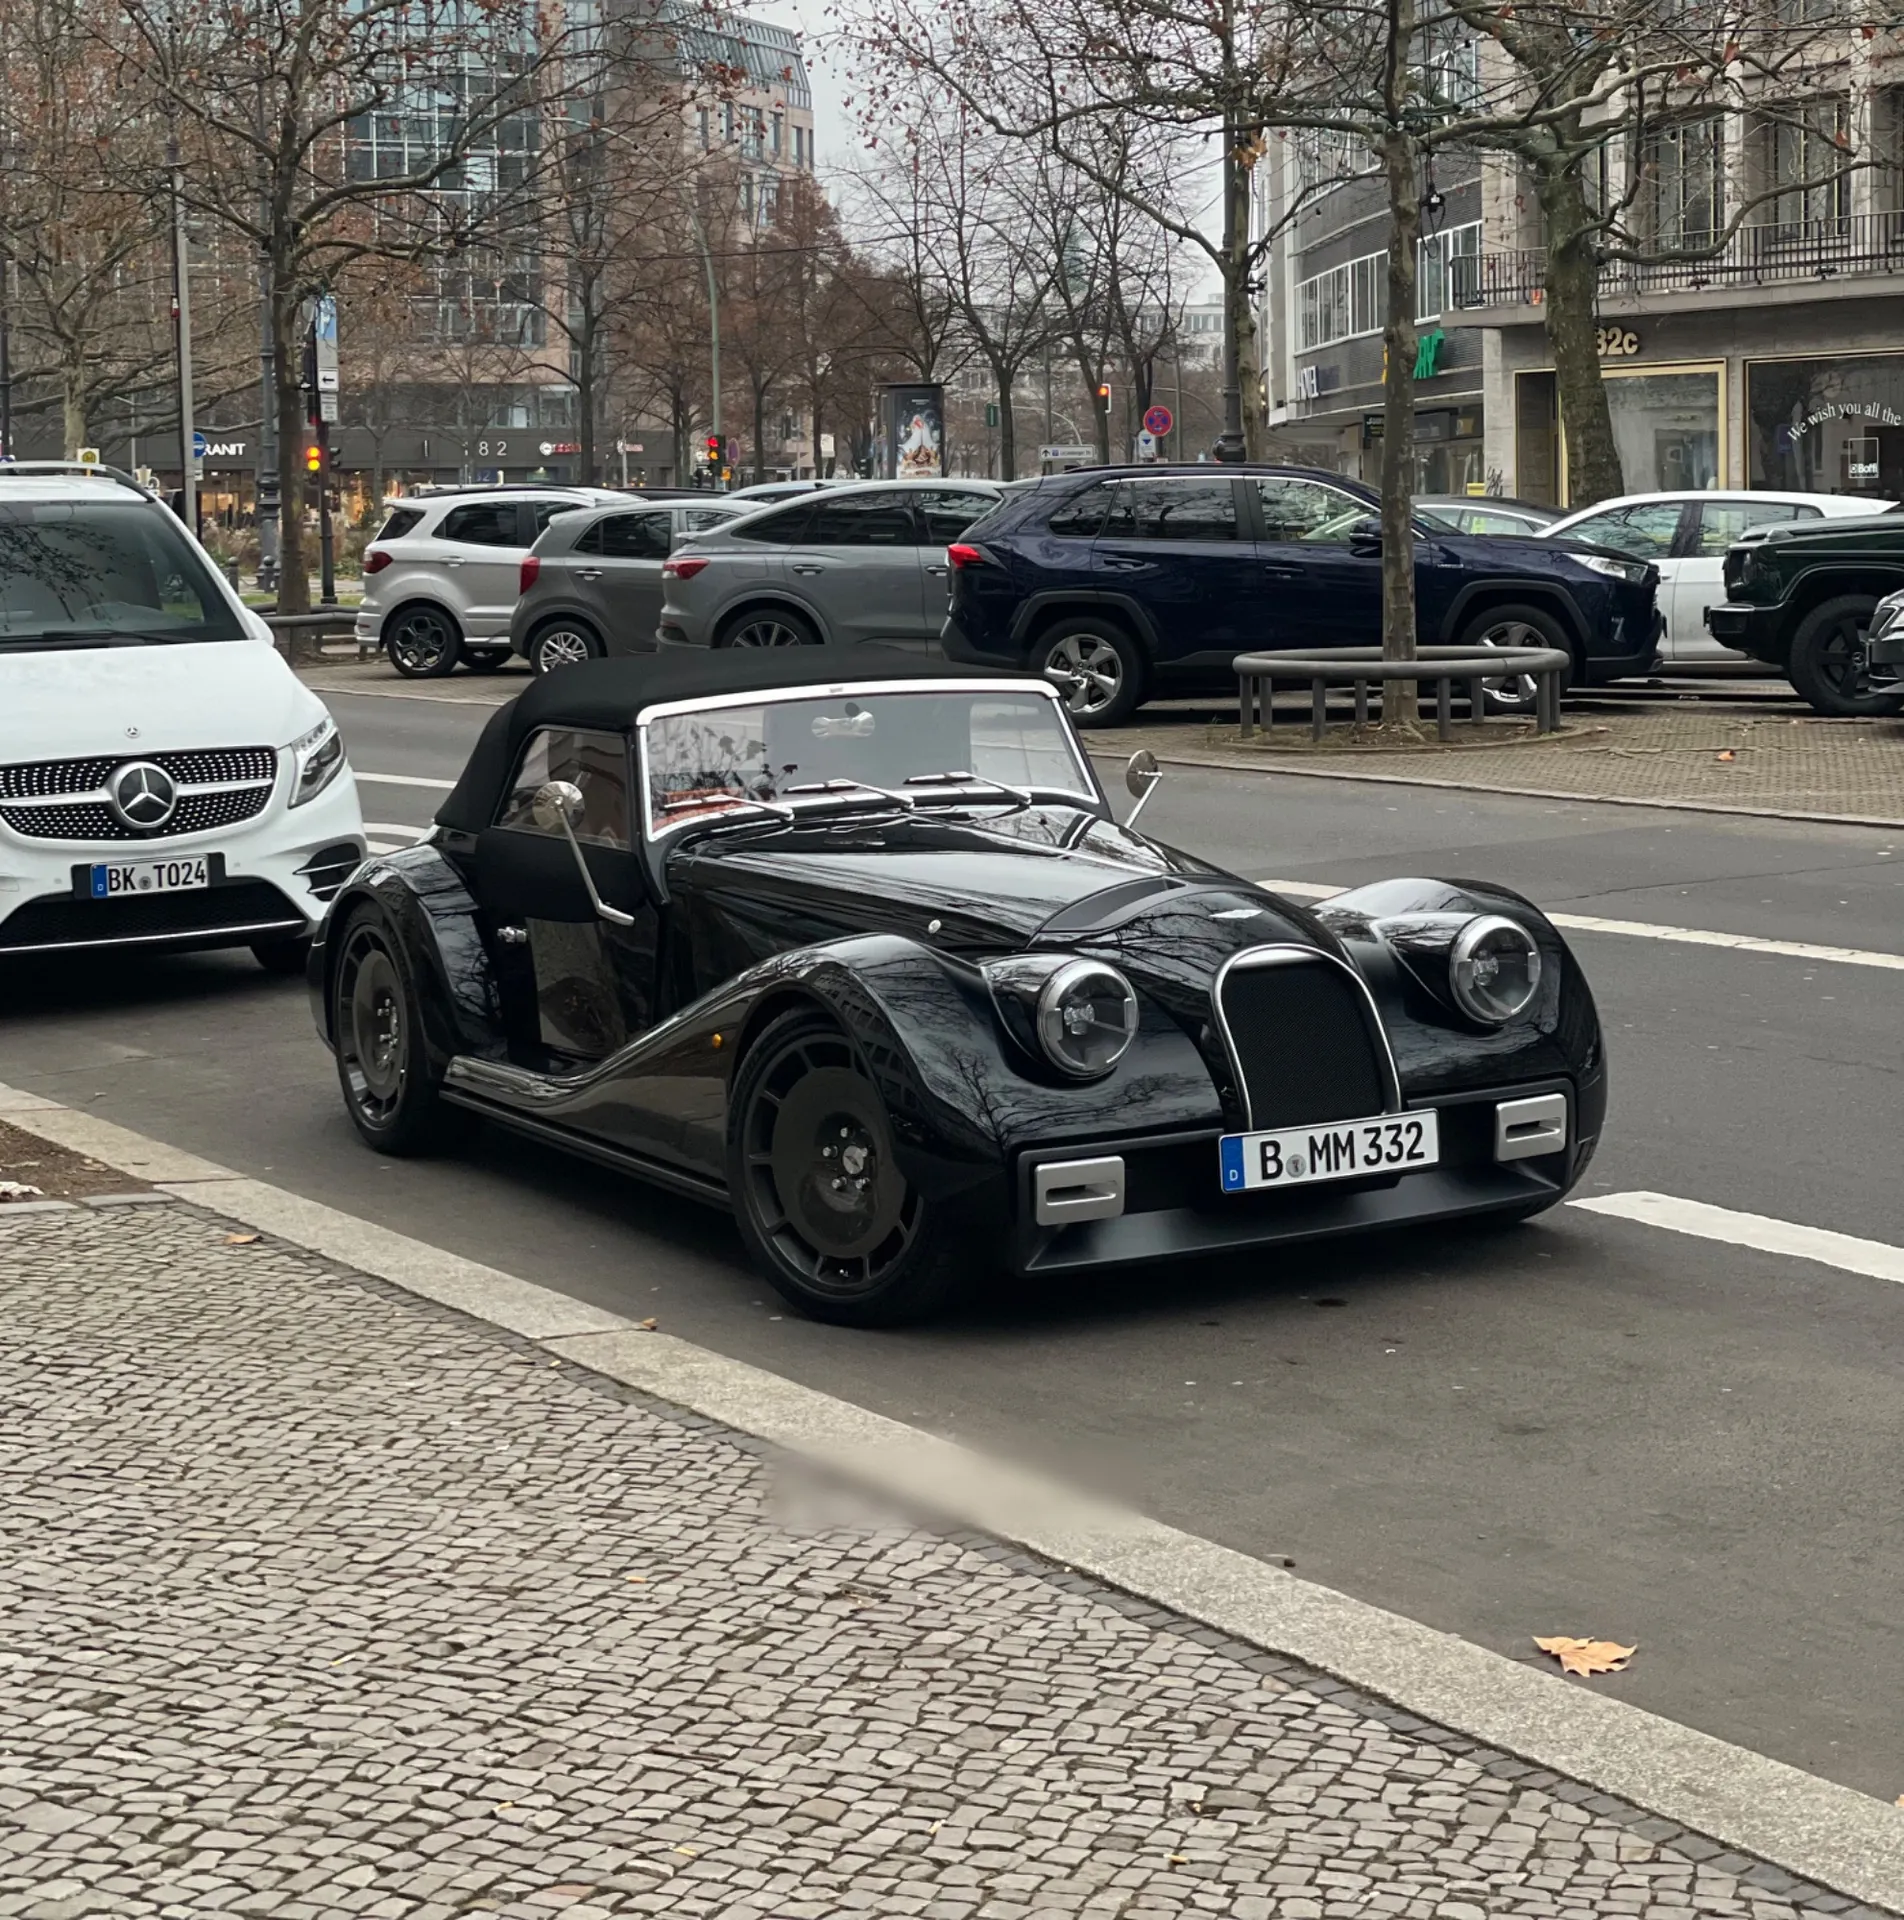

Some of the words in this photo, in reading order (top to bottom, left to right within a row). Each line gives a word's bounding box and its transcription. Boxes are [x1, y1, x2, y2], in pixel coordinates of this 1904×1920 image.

[1787, 419, 1808, 441] We
[1807, 402, 1837, 426] wish
[1838, 402, 1861, 420] you
[1864, 401, 1880, 419] all
[1882, 406, 1902, 426] the
[97, 883, 104, 892] D
[108, 866, 136, 892] BK
[1229, 1169, 1239, 1181] D
[1260, 1140, 1283, 1180] B
[1308, 1130, 1356, 1174] MM
[1363, 1121, 1425, 1166] 332
